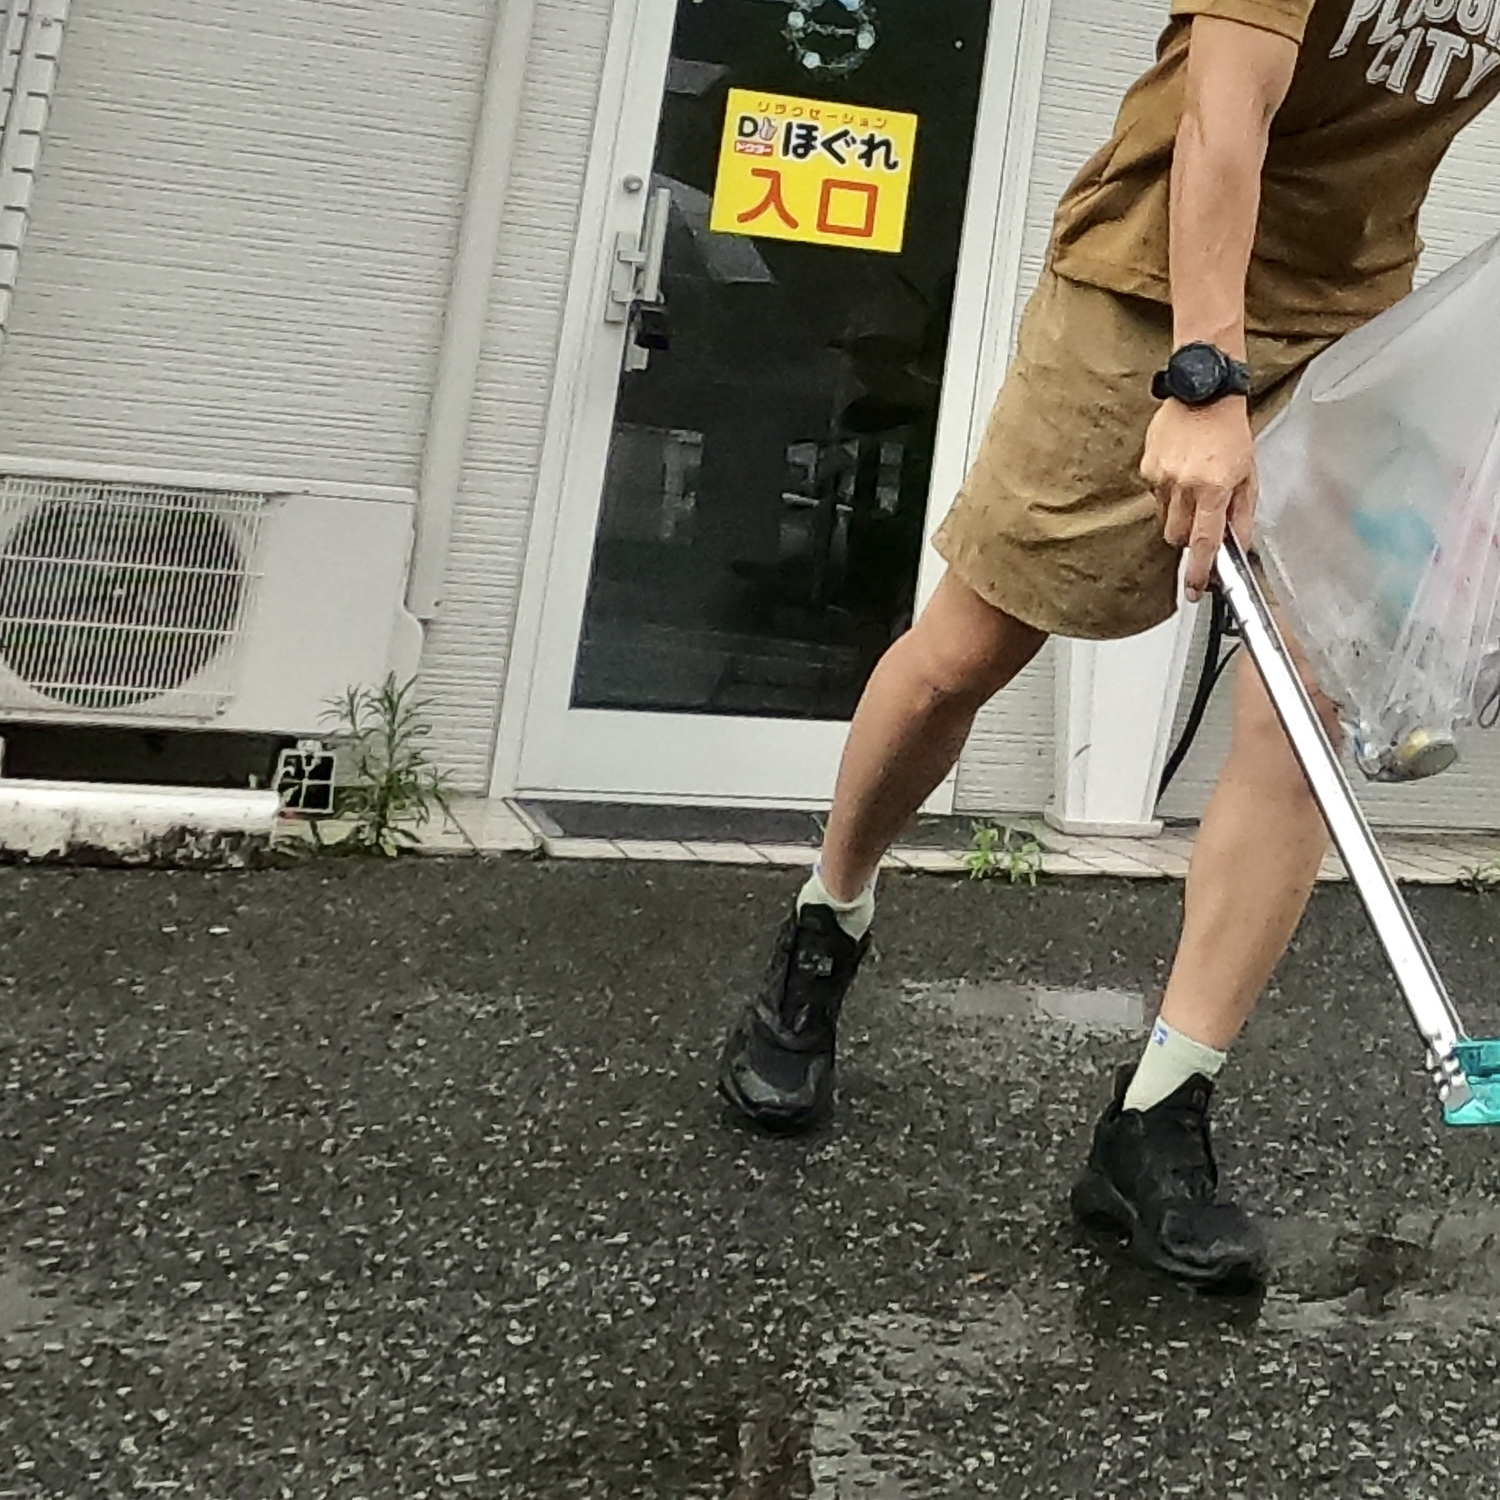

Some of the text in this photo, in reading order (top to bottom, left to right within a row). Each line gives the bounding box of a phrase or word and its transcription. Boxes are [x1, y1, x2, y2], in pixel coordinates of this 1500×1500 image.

[782, 121, 900, 171] ほぐれ
[737, 168, 879, 238] 入口
